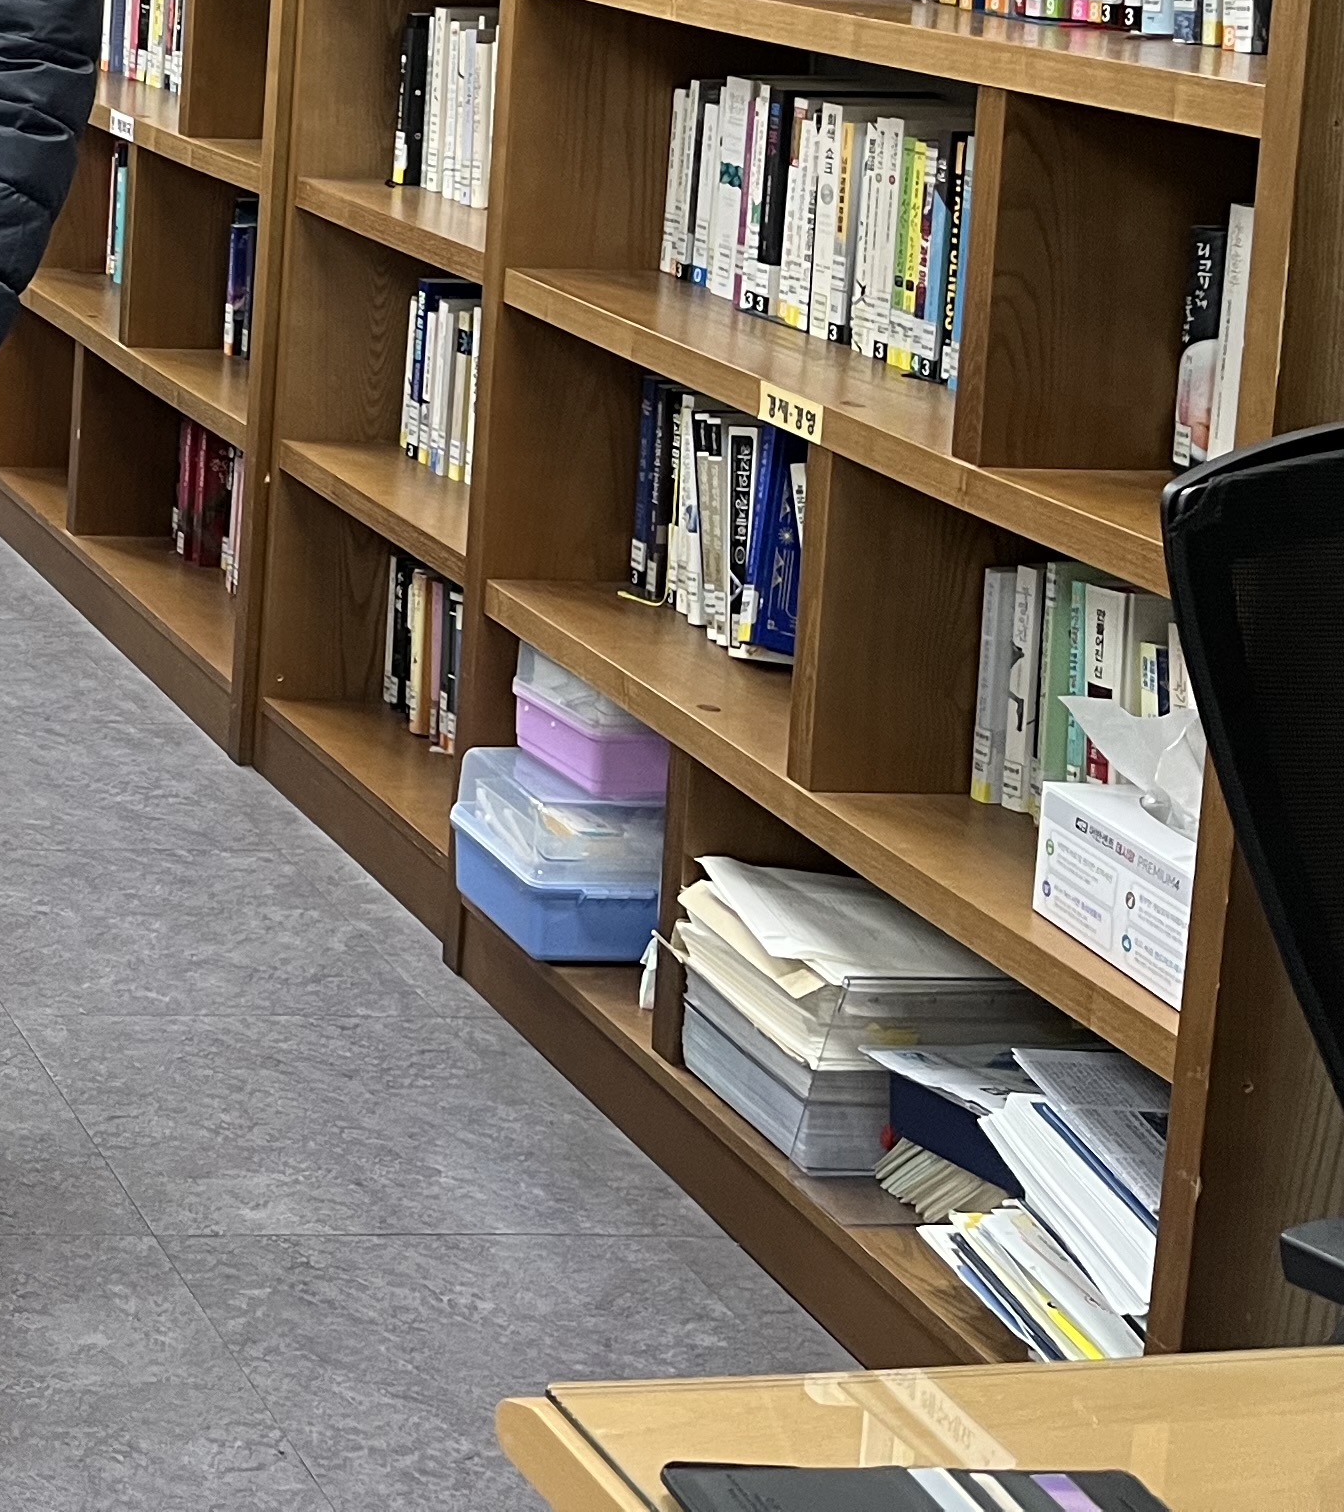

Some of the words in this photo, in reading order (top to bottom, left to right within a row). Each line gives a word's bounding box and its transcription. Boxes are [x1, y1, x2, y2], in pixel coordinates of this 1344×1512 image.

[1073, 0, 1082, 16] 6
[1102, 4, 1110, 22] 3
[1124, 8, 1134, 25] 3
[824, 147, 835, 175] 쇼크
[676, 263, 682, 278] 3
[693, 268, 702, 283] 0
[745, 293, 753, 310] 3
[756, 296, 764, 312] 3
[829, 324, 838, 340] 3
[875, 342, 884, 359] 3
[921, 359, 930, 376] 3
[766, 393, 816, 436] 경제·경영
[407, 444, 414, 457] 3
[632, 571, 638, 584] 3
[1094, 608, 1106, 663] 만들어진
[1094, 666, 1103, 680] 신
